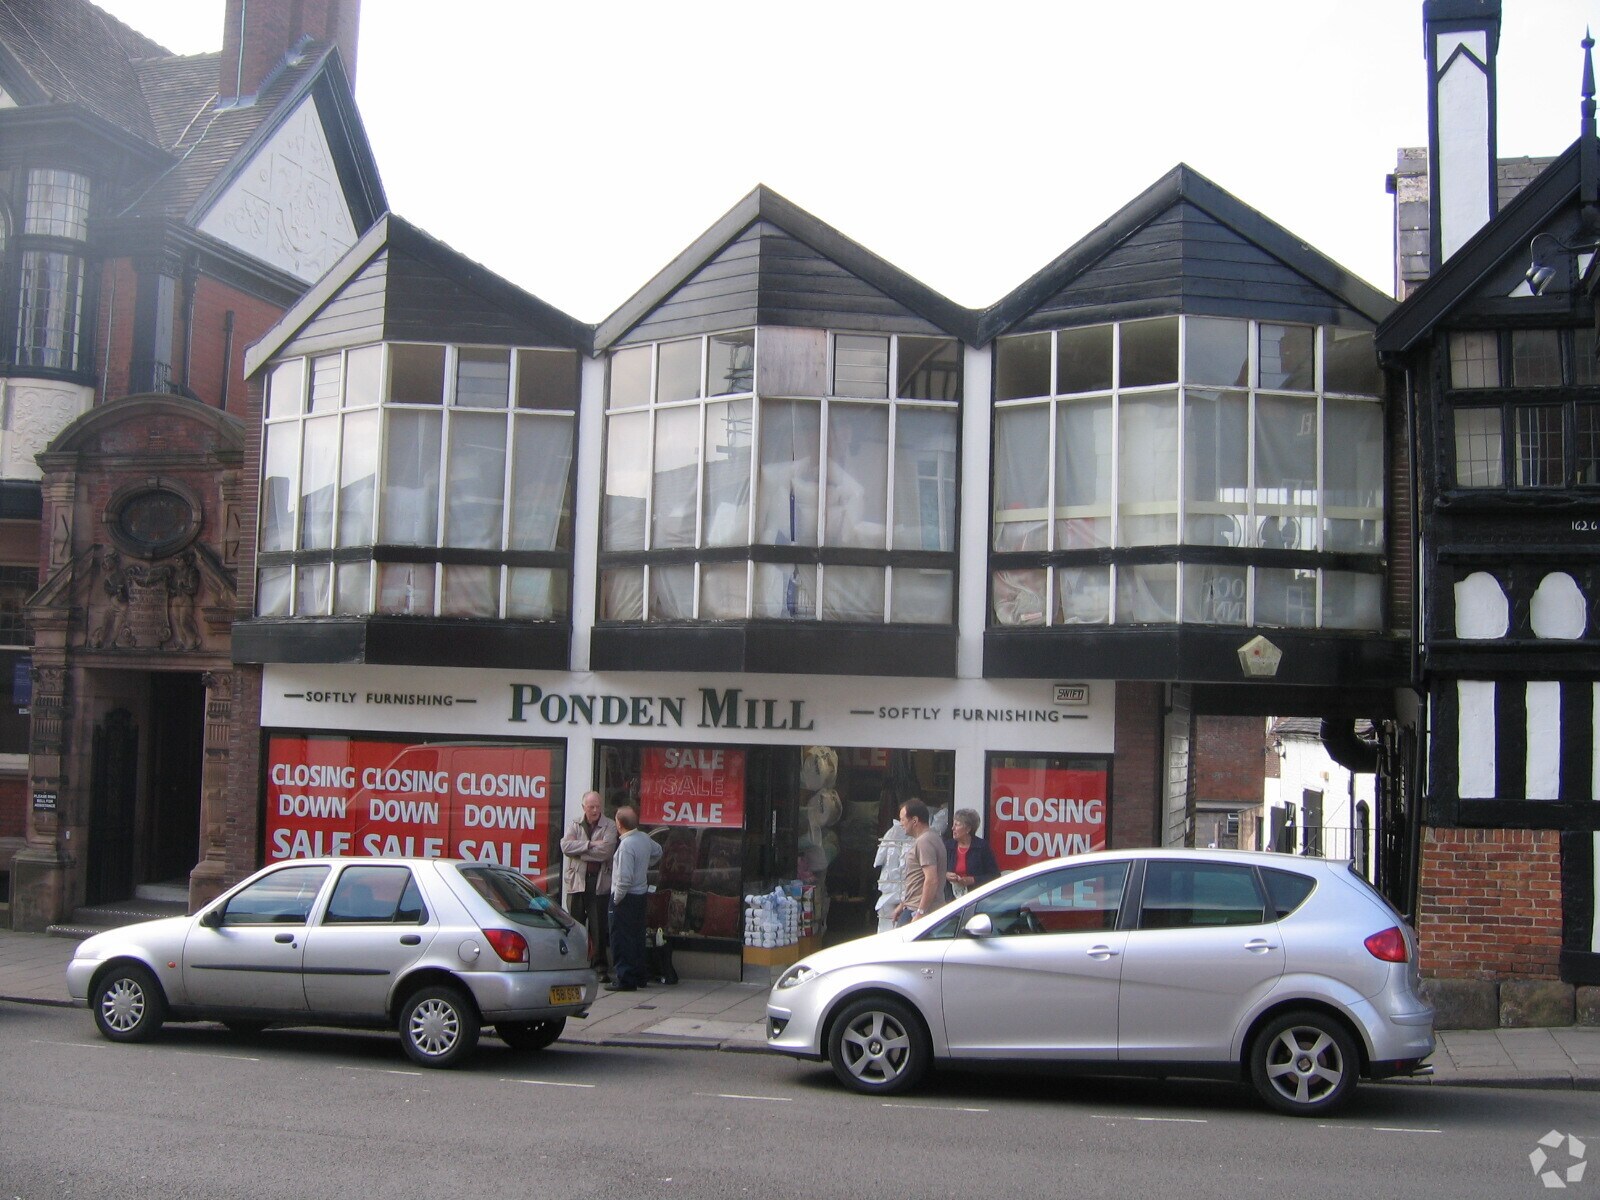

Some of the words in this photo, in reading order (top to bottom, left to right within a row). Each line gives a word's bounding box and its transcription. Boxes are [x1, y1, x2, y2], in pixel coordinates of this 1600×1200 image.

[1571, 520, 1598, 531] 1626
[305, 691, 357, 703] SOFTLY
[366, 693, 453, 706] FURNISHING
[508, 683, 686, 727] PONDEN
[697, 687, 815, 731] MILL
[1057, 688, 1085, 700] SWIFT
[878, 706, 941, 720] SOFTLY
[953, 708, 1060, 722] FURNISHING
[664, 748, 724, 770] SALE
[271, 763, 355, 789] CLOSING
[361, 767, 449, 794] CLOSING
[456, 772, 546, 799] CLOSING
[662, 775, 725, 797] SALE
[279, 794, 346, 819] DOWN
[369, 798, 439, 825] DOWN
[464, 804, 536, 830] DOWN
[662, 801, 723, 823] SALE
[995, 796, 1102, 824] CLOSING
[271, 828, 351, 859] SALE
[363, 833, 444, 859] SALE
[1005, 830, 1091, 858] DOWN
[458, 839, 541, 876] SALE
